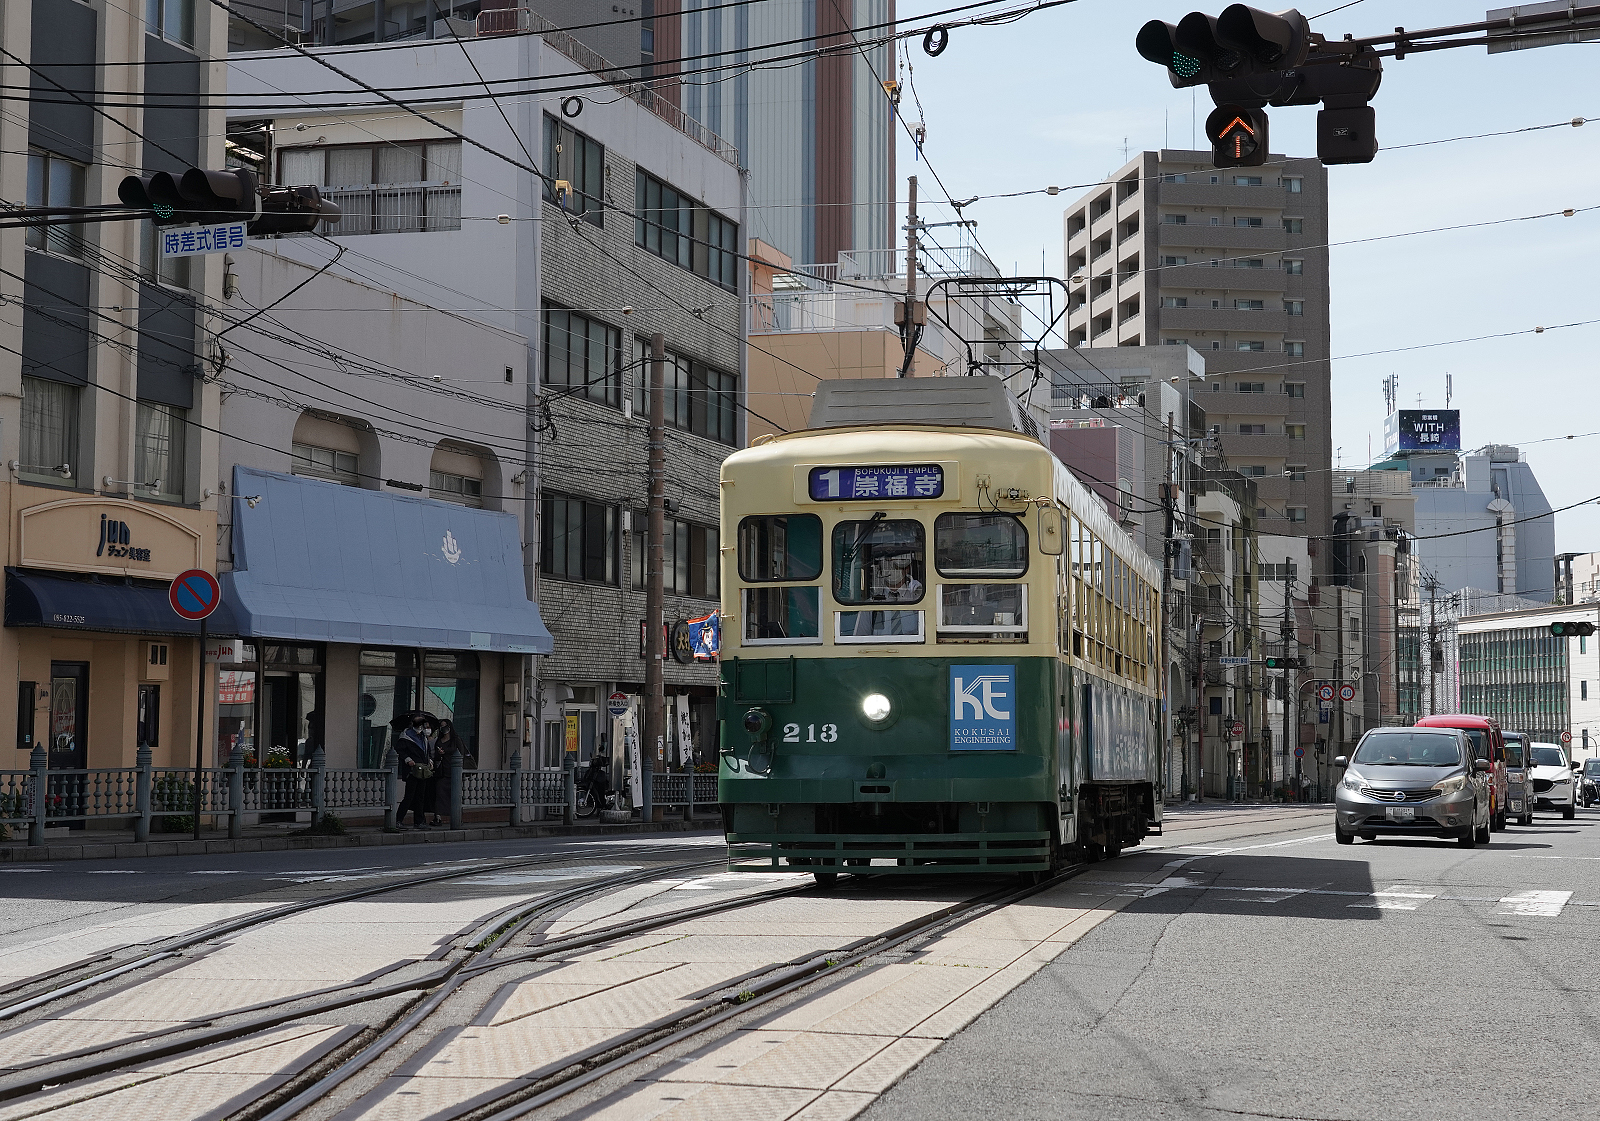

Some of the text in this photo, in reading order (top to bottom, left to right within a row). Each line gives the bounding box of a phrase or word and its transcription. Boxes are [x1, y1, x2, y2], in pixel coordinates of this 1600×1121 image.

[165, 226, 243, 253] 時差式信号
[1413, 422, 1444, 432] WITH
[1420, 432, 1440, 442] 長崎
[904, 466, 938, 474] TEMPLE
[819, 469, 840, 497] 1
[855, 474, 942, 497] 崇福寺
[97, 513, 131, 557] jun
[216, 644, 233, 660] jun
[954, 675, 1010, 720] KE
[1342, 689, 1352, 697] 40
[783, 723, 838, 743] 213
[954, 728, 1010, 736] KOKUSAI
[954, 736, 1011, 744] ENGINEERING
